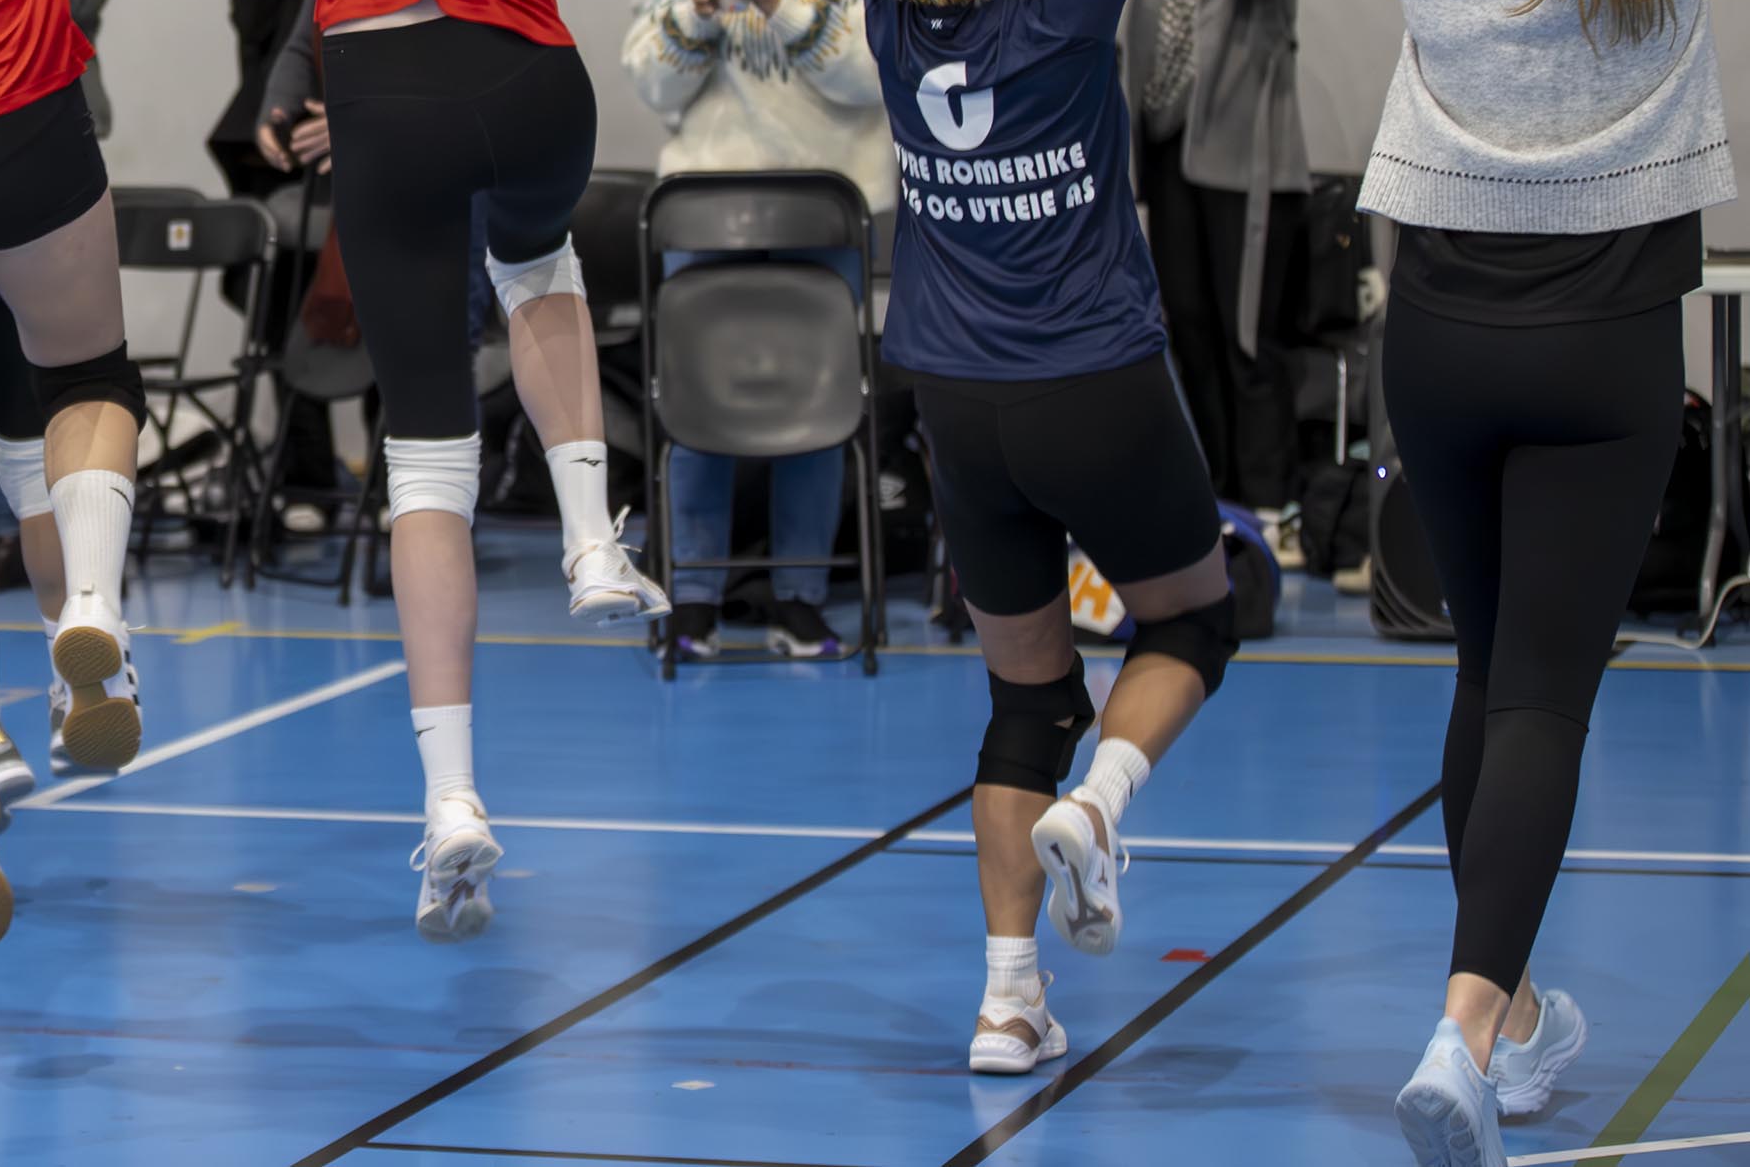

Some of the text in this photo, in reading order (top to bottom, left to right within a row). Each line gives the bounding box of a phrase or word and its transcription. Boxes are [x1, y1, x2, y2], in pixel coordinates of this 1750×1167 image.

[894, 141, 1086, 185] VRE ROMERIKE
[927, 194, 964, 222] OG
[968, 189, 1057, 223] UTLEIE
[1066, 174, 1095, 209] AS
